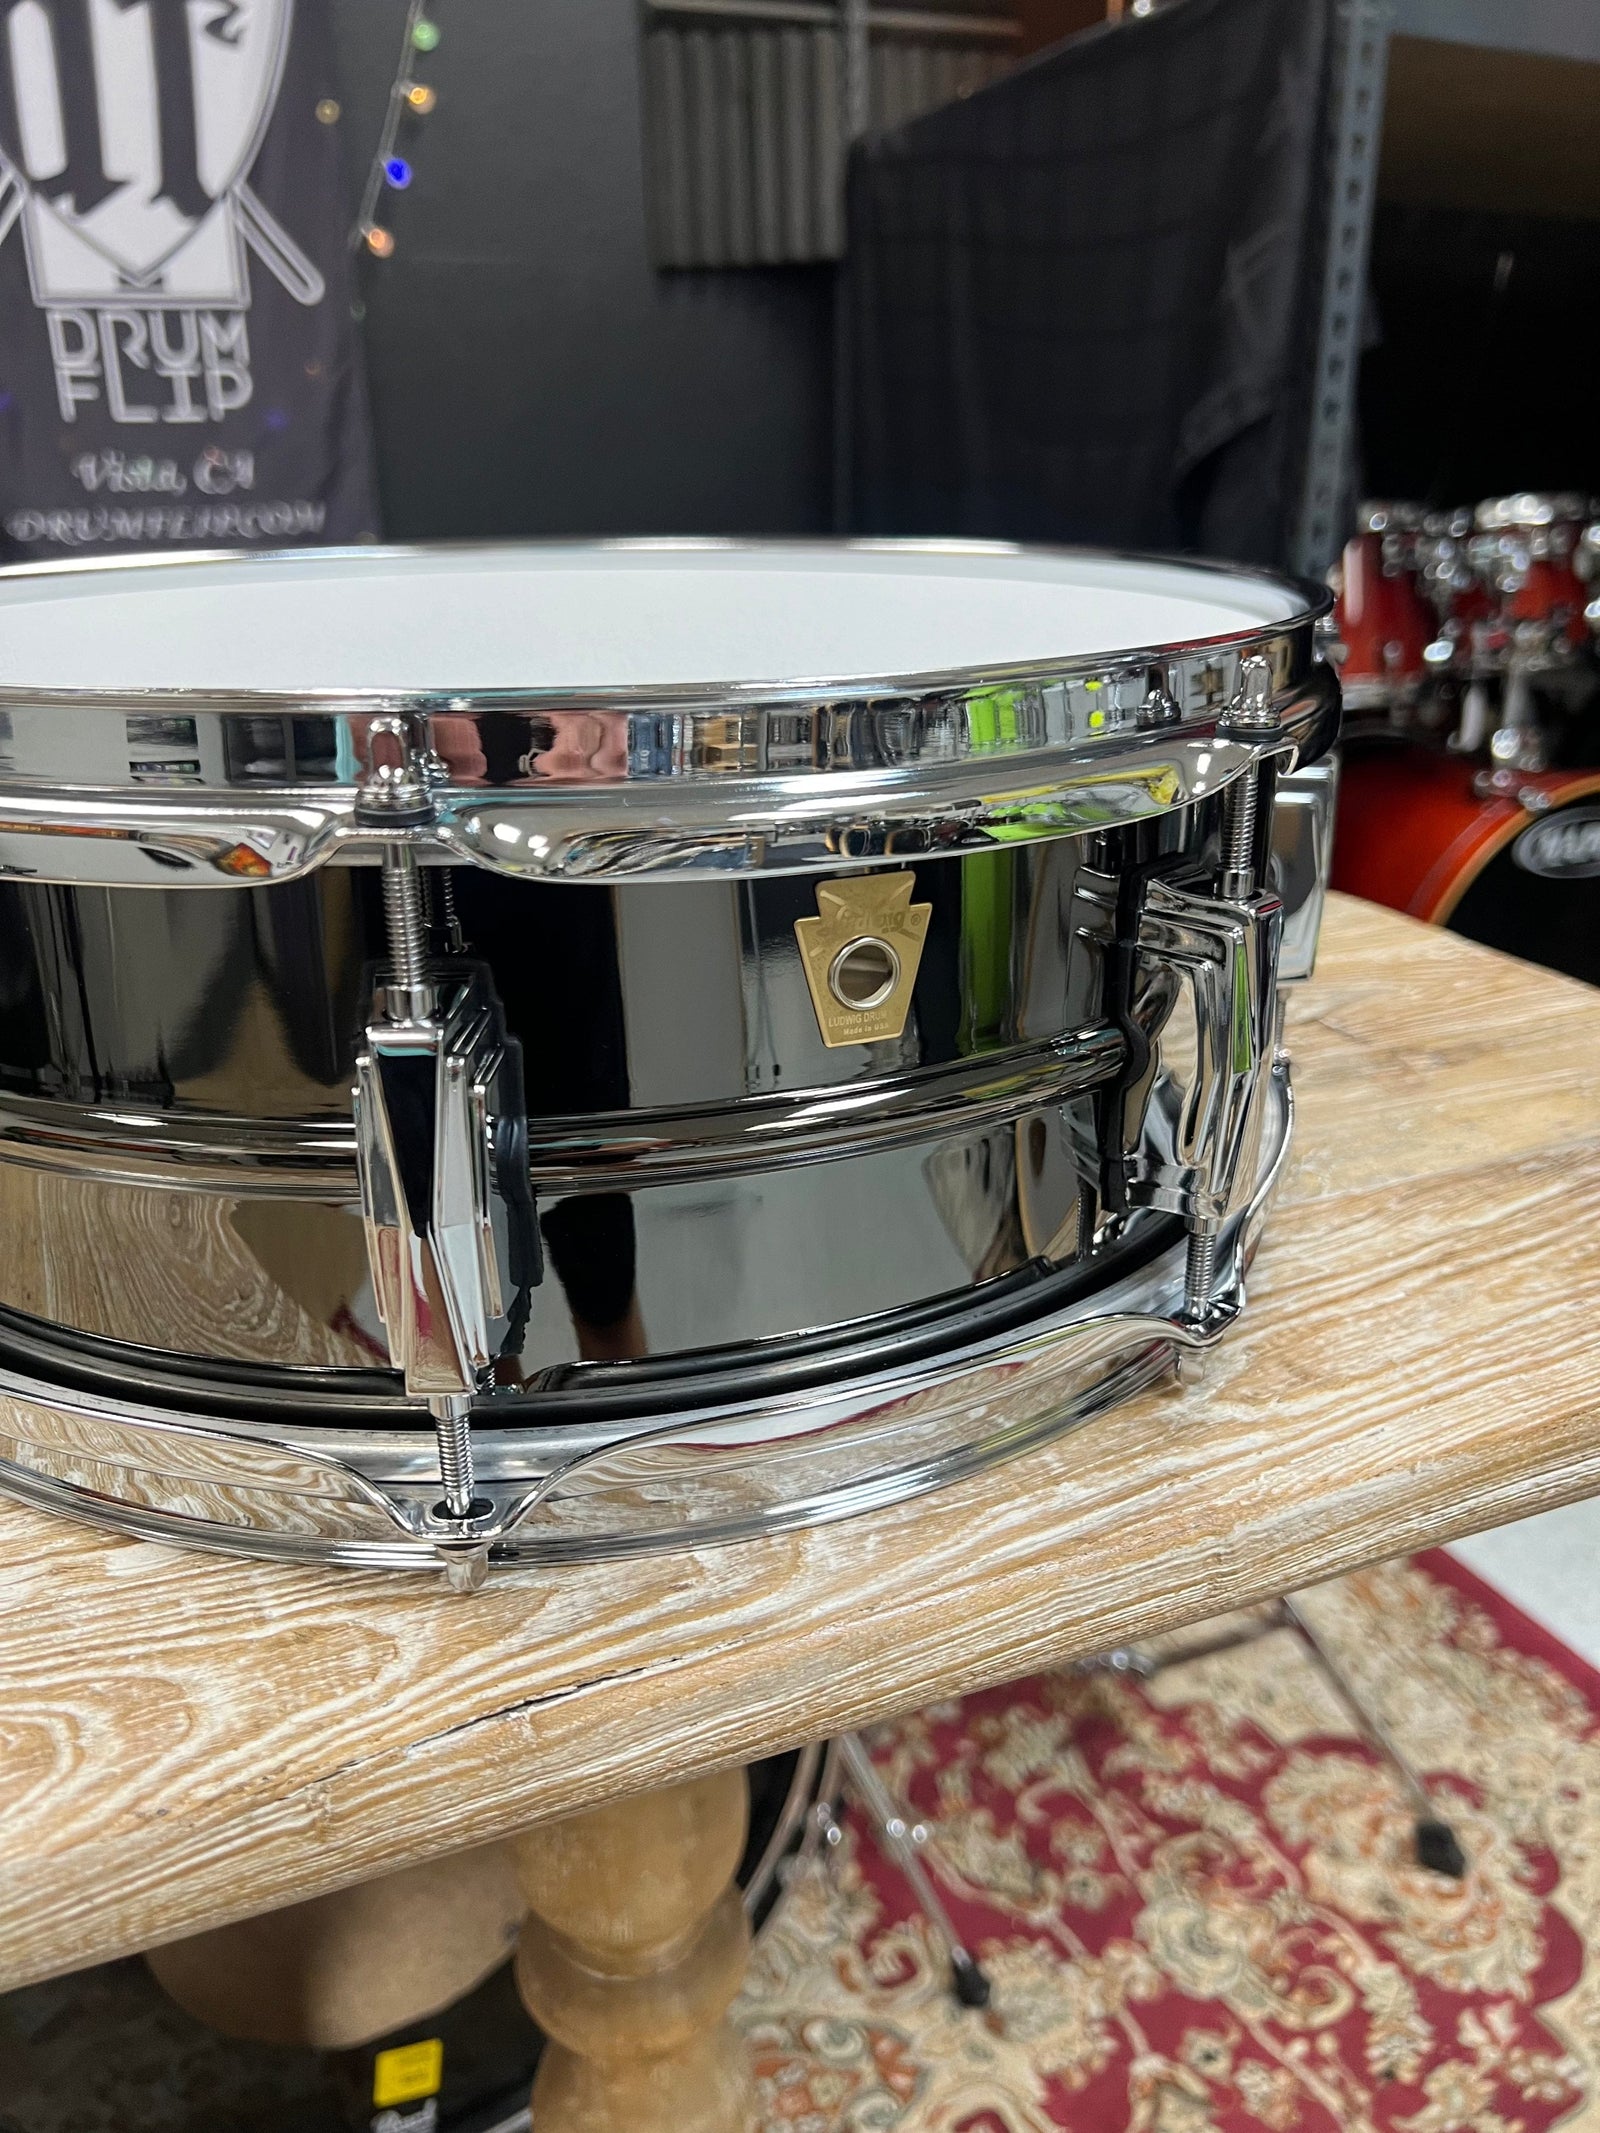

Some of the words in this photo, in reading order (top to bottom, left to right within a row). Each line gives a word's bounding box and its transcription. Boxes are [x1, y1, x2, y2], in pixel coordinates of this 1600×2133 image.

[46, 308, 250, 369] DRUM
[55, 366, 253, 423] FLIP
[828, 1013, 862, 1028] LUDWIG
